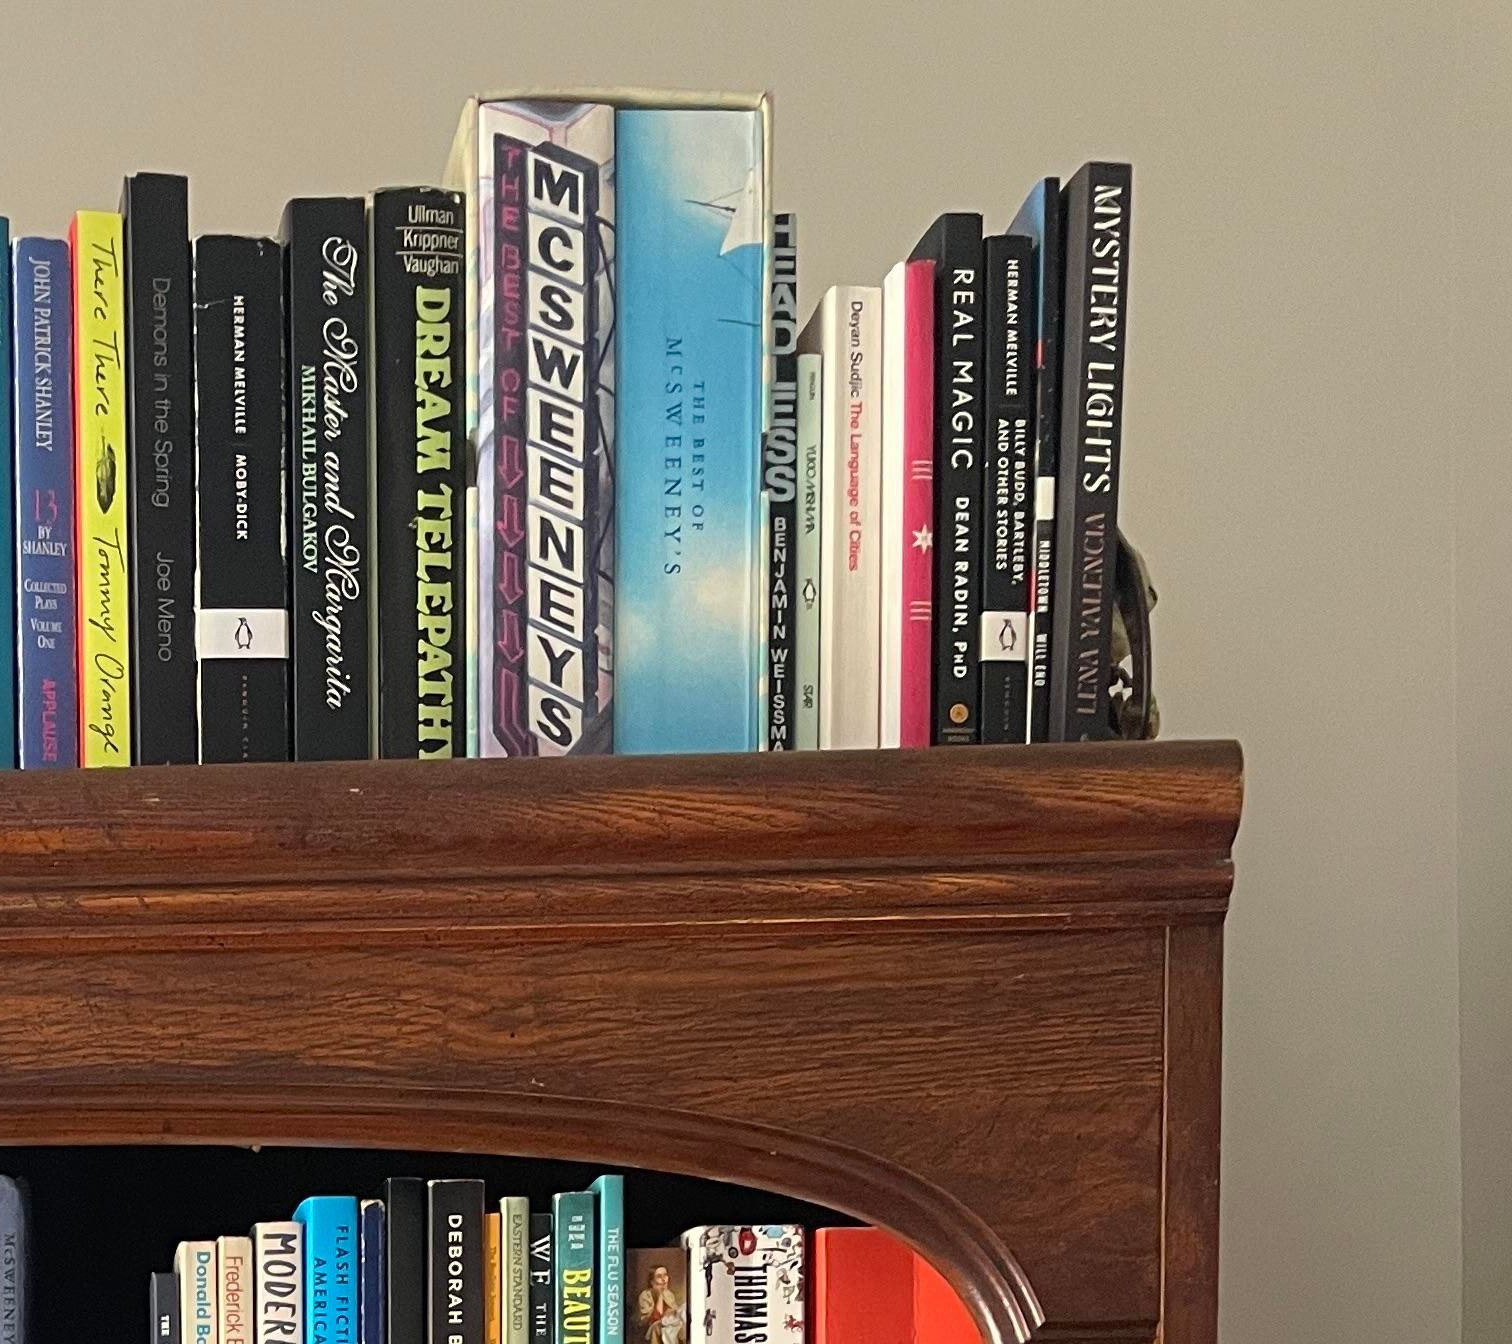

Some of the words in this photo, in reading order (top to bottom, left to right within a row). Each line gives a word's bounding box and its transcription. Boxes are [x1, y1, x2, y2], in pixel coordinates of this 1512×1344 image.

[951, 268, 976, 347] REAL
[1088, 184, 1123, 352] MYSTERY
[232, 295, 246, 363] HERMAN
[233, 366, 248, 435] MELVILLE
[950, 359, 975, 470] MAGIC
[1082, 361, 1116, 494] LIGHTS
[194, 1250, 212, 1322] Donald
[447, 1214, 464, 1326] DEBORAH
